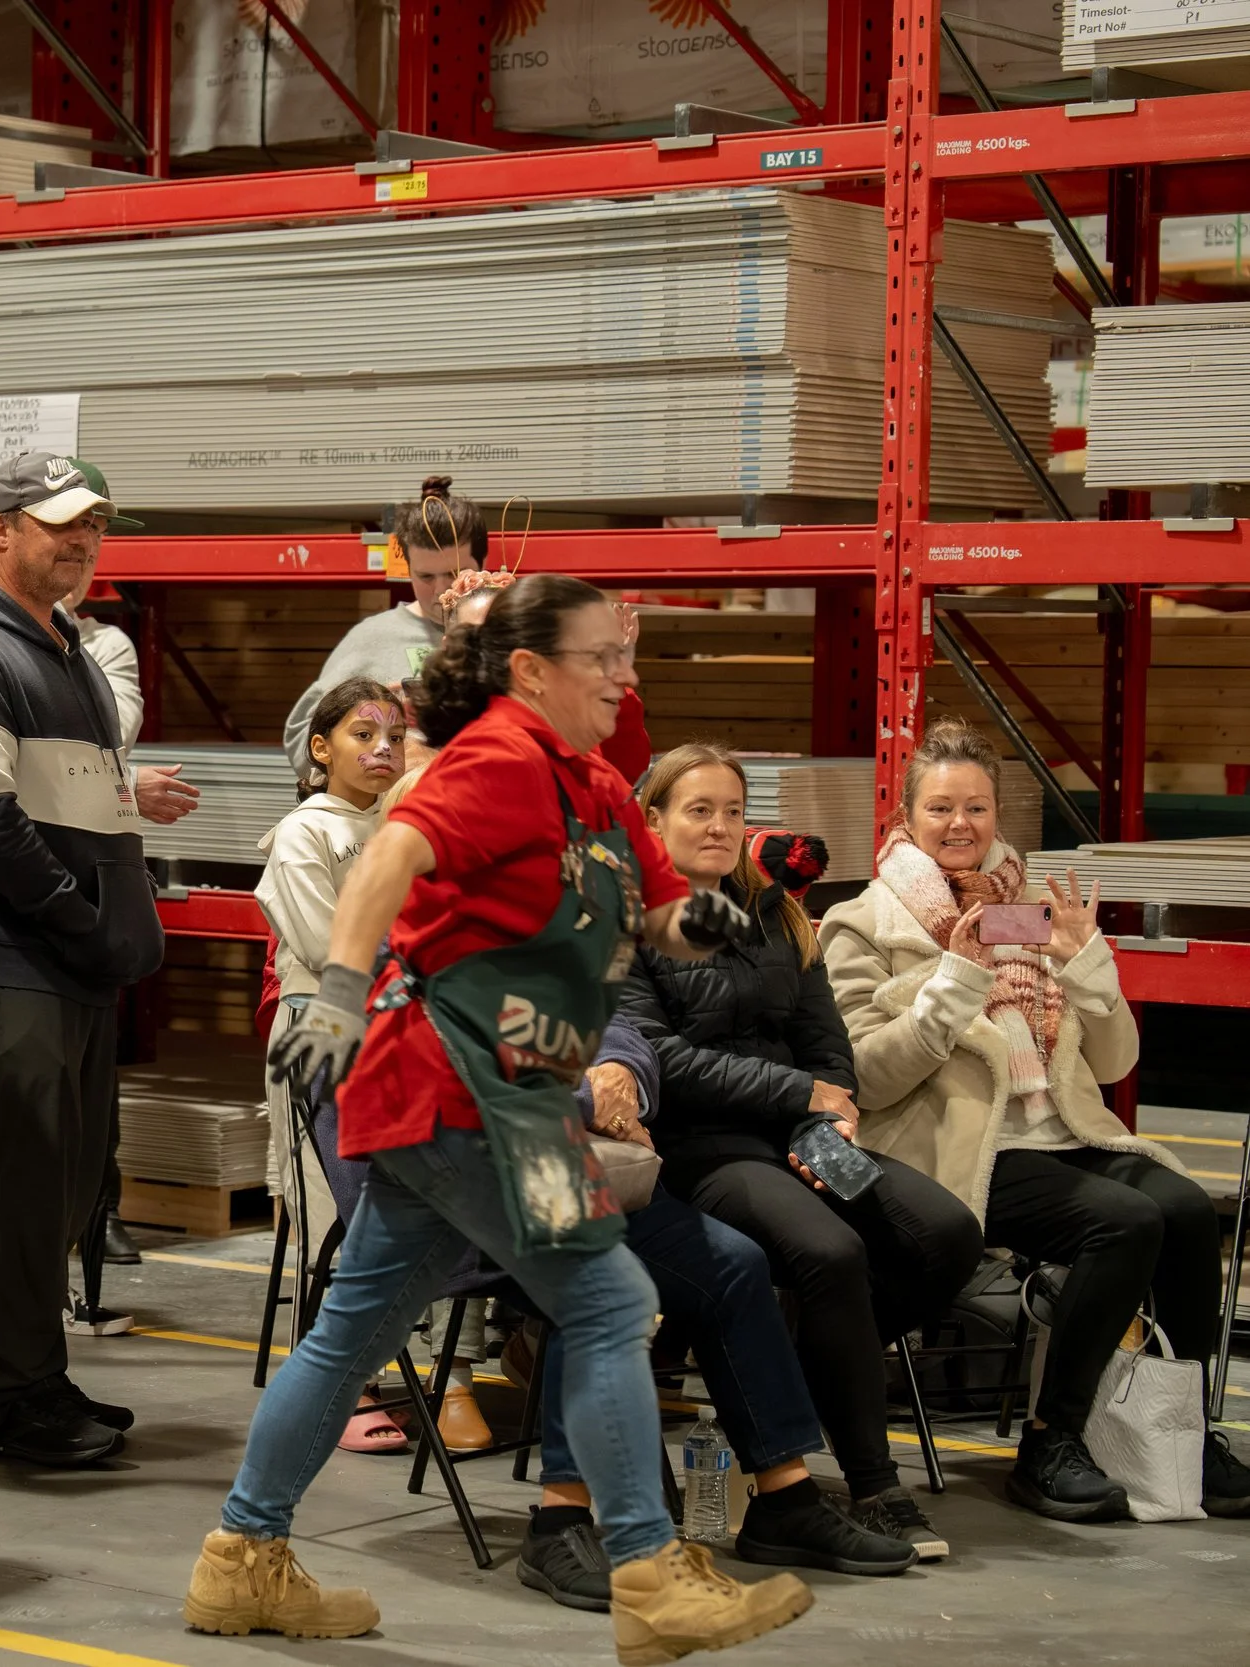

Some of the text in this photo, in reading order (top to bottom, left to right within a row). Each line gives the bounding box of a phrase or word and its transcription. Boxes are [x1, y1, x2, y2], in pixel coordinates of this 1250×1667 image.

[1081, 5, 1131, 18] Timeslot-
[1079, 22, 1127, 34] Part No#
[936, 140, 972, 149] MAXIMUM
[975, 137, 1031, 151] 4500 kgs.
[936, 147, 972, 156] LOADING
[766, 151, 816, 167] BAY 15
[299, 447, 318, 465] RE
[325, 447, 365, 465] 10mm
[382, 446, 441, 463] 1200mm
[457, 443, 519, 462] 2400mm
[929, 546, 964, 554] MAXIMUM
[967, 546, 1023, 560] 4500 kgs.
[929, 553, 964, 561] LOADING
